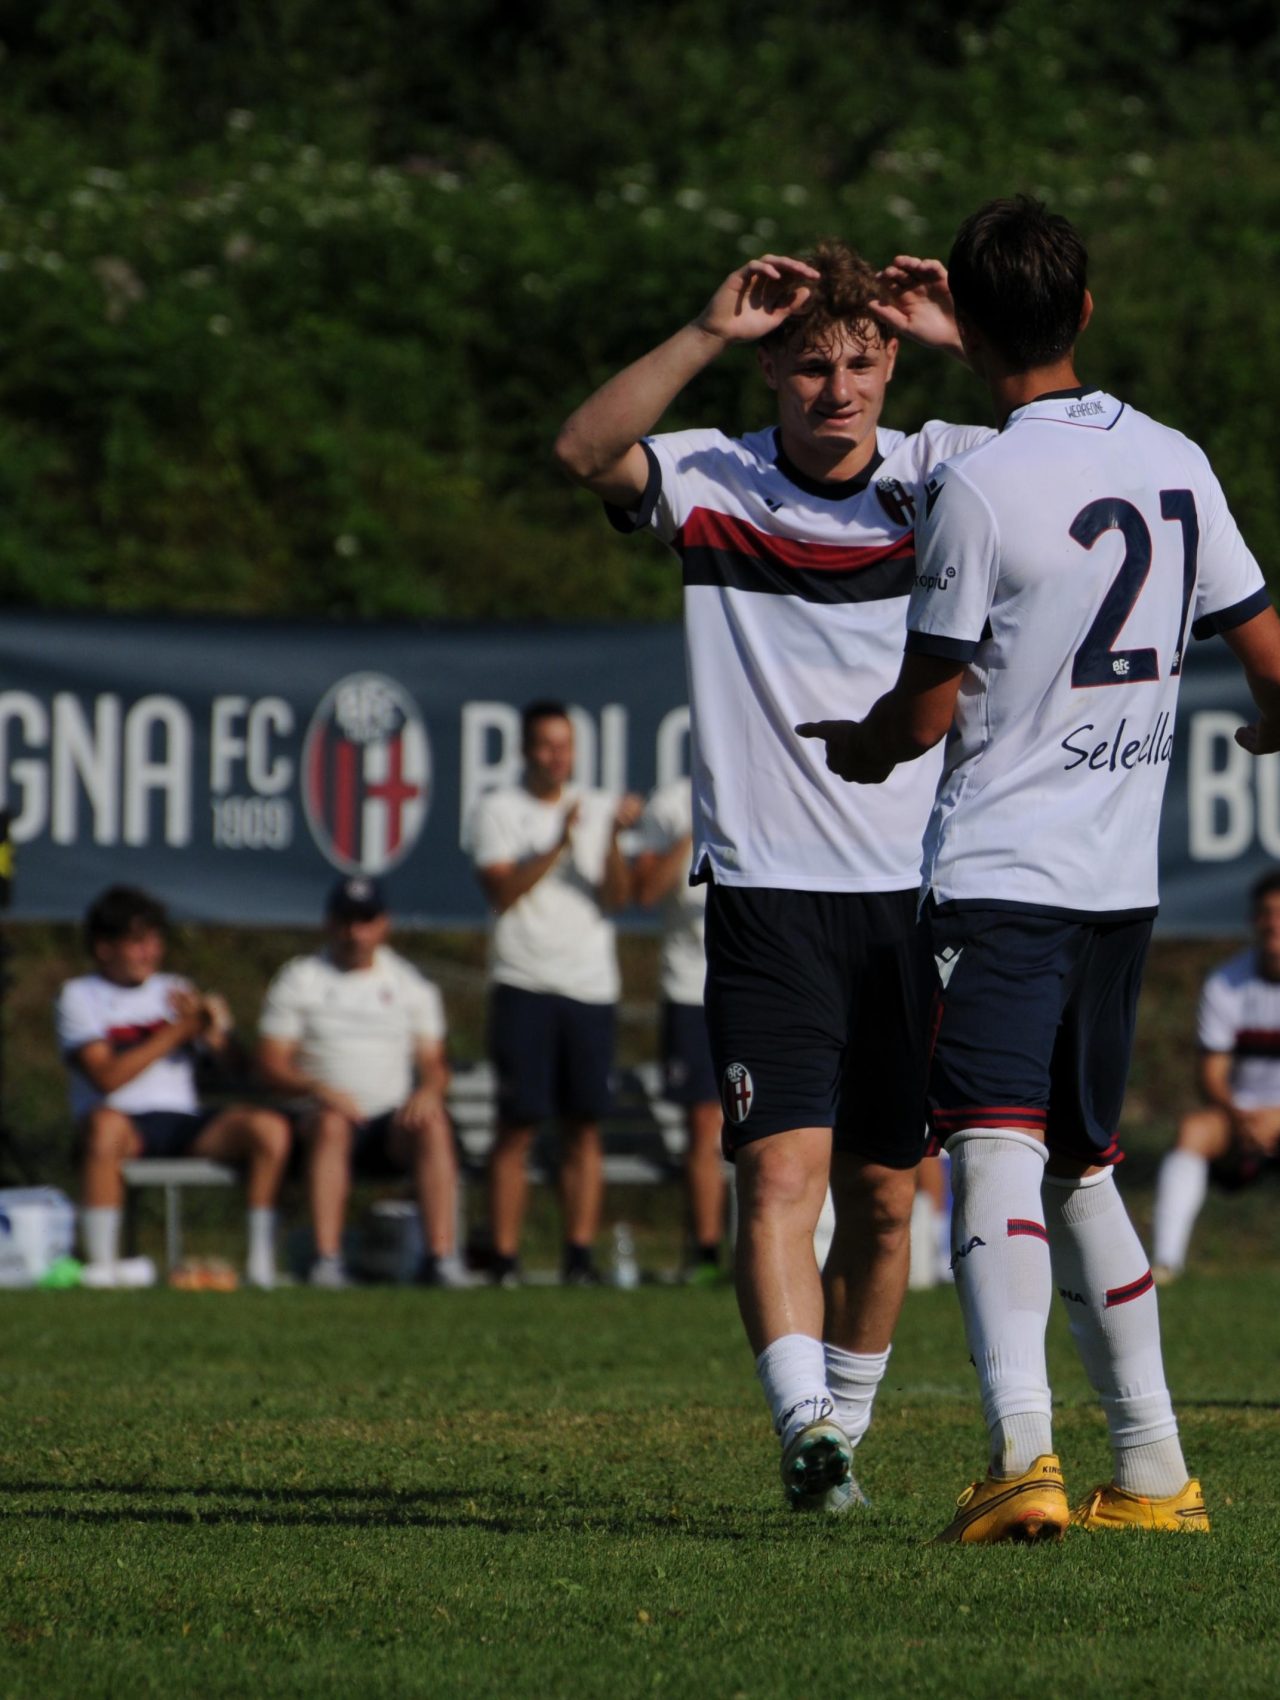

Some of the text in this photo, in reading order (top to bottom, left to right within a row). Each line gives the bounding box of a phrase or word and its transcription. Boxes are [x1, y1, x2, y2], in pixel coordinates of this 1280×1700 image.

[1068, 489, 1199, 689] 21
[211, 695, 294, 796] FC
[211, 798, 293, 849] 1909
